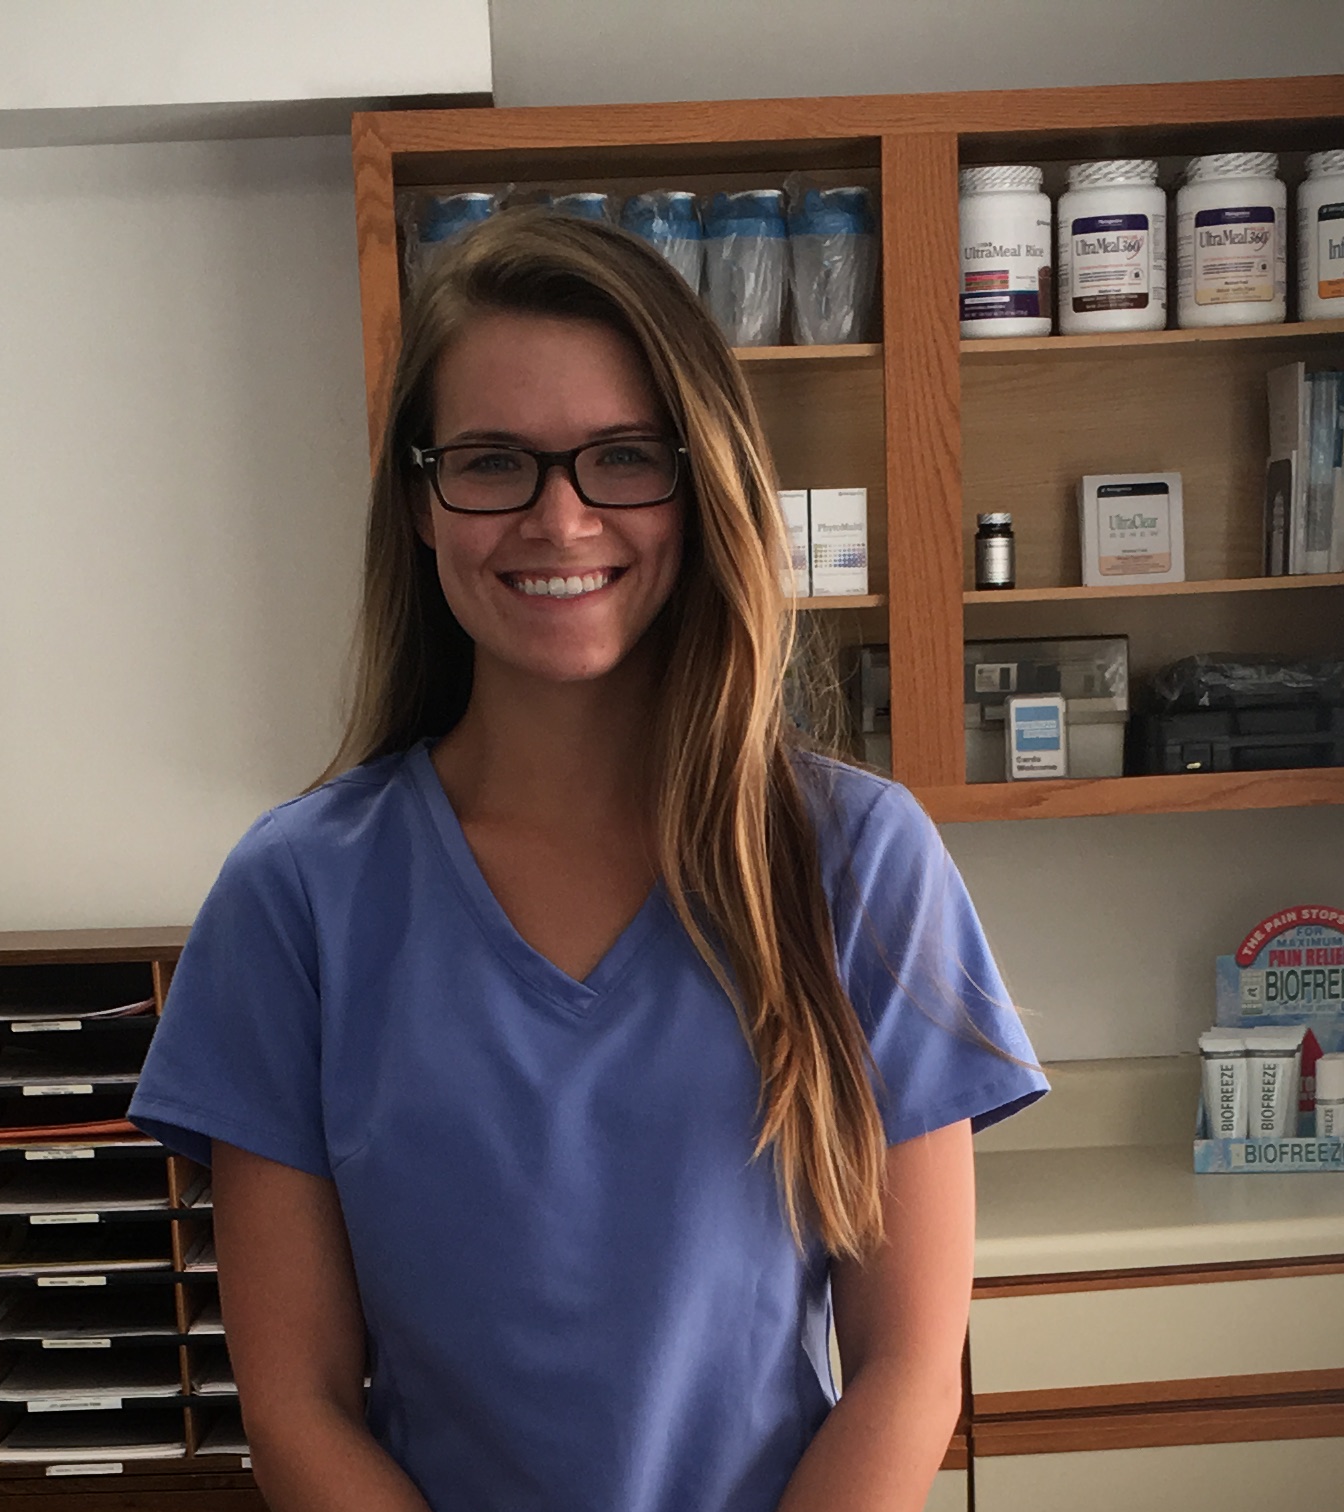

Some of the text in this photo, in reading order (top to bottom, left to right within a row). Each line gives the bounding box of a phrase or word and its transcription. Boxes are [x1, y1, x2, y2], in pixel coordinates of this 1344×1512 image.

[964, 243, 1022, 260] UltraMeal
[1242, 931, 1266, 956] THE
[1264, 912, 1297, 933] PAIN
[1296, 927, 1323, 937] FOR
[1276, 938, 1343, 947] MAXIMUM
[1269, 950, 1302, 967] PAIN
[1220, 1064, 1234, 1132] BIOFREEZE
[1261, 1063, 1276, 1131] BIOFREEZE
